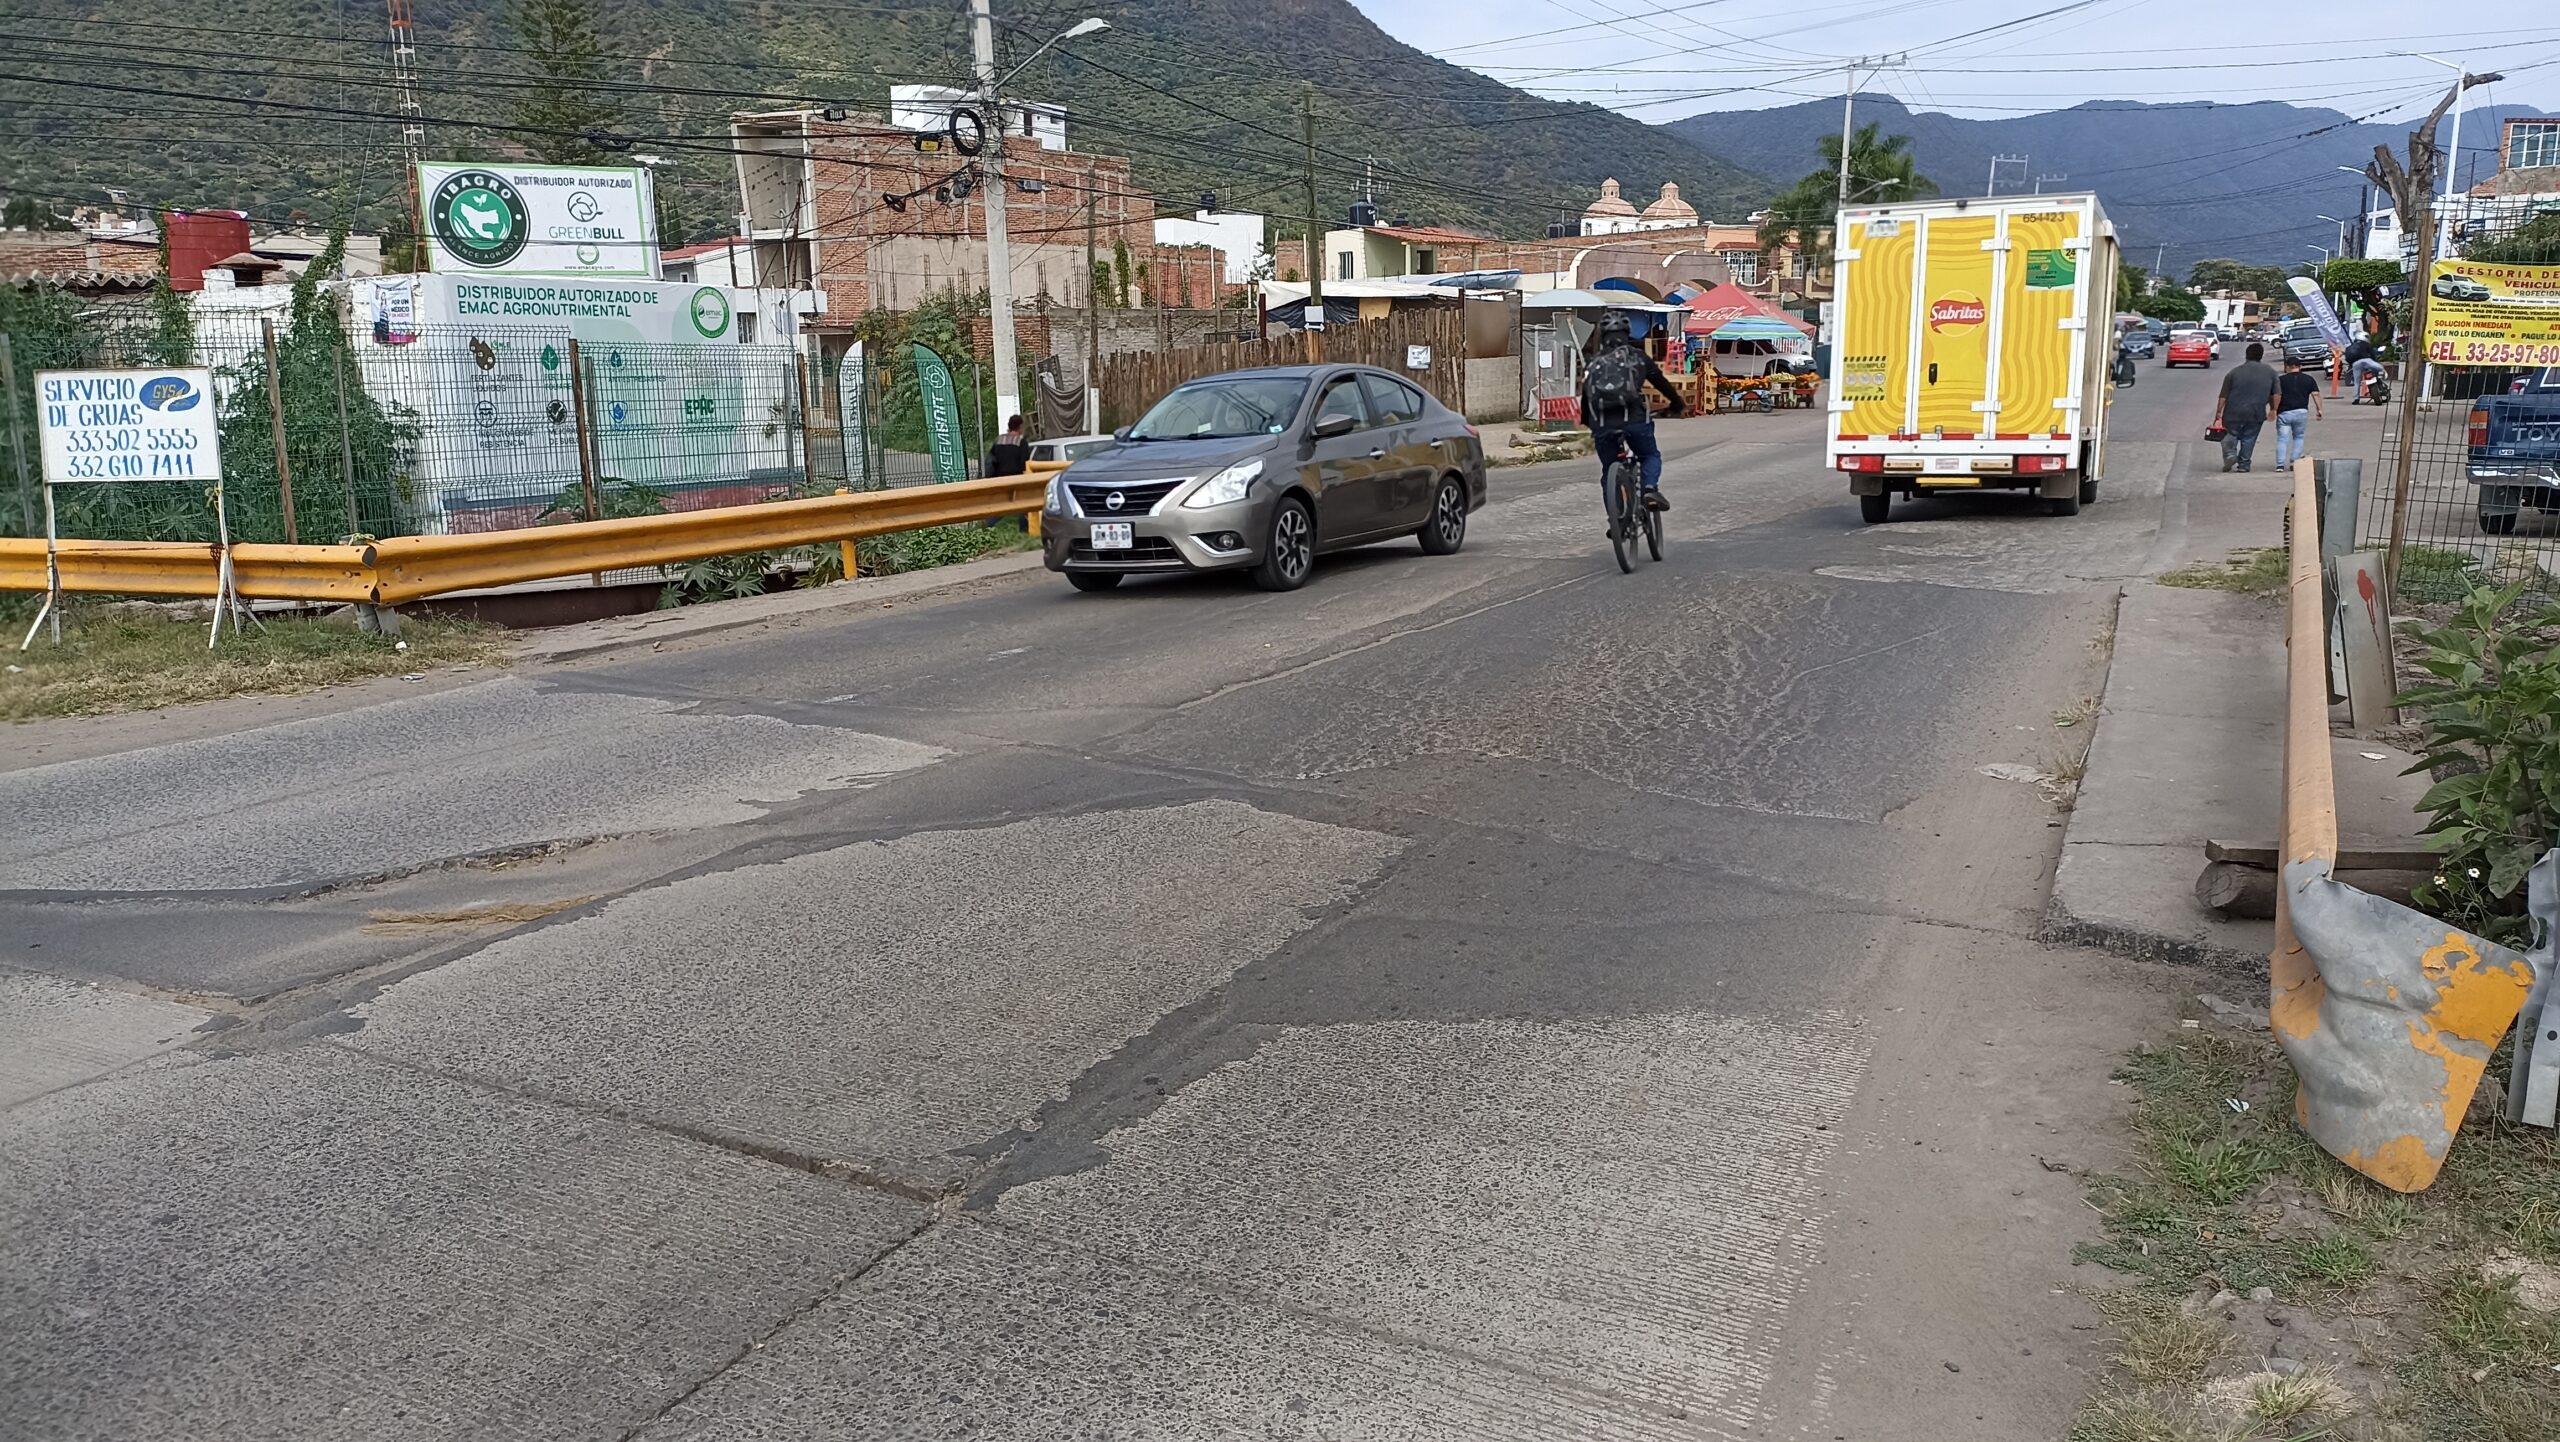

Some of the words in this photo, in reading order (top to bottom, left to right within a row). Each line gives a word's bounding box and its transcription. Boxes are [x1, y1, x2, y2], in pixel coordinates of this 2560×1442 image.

[441, 176, 511, 200] IBAGRO
[514, 176, 574, 187] DISTRIBUIDOR
[578, 177, 632, 188] AUTORIZADO
[2023, 212, 2065, 223] 654423
[549, 226, 625, 239] GREENBULL
[2457, 266, 2532, 278] GESTORIA
[457, 285, 558, 301] DISTRIBUIDOR
[559, 289, 642, 304] AUTORIZADO
[643, 291, 658, 304] DE
[459, 301, 499, 314] EMAC
[503, 303, 631, 317] AGRONUTRIMENTAL
[1930, 305, 1985, 321] Sabritas
[2472, 321, 2512, 329] INMEDIATA
[2429, 342, 2461, 361] CEL.
[45, 378, 135, 401] SERVICIO
[48, 405, 71, 427] DE
[147, 428, 198, 450] 5555
[68, 455, 104, 477] 332
[108, 454, 143, 477] 610
[148, 453, 194, 476] 7411
